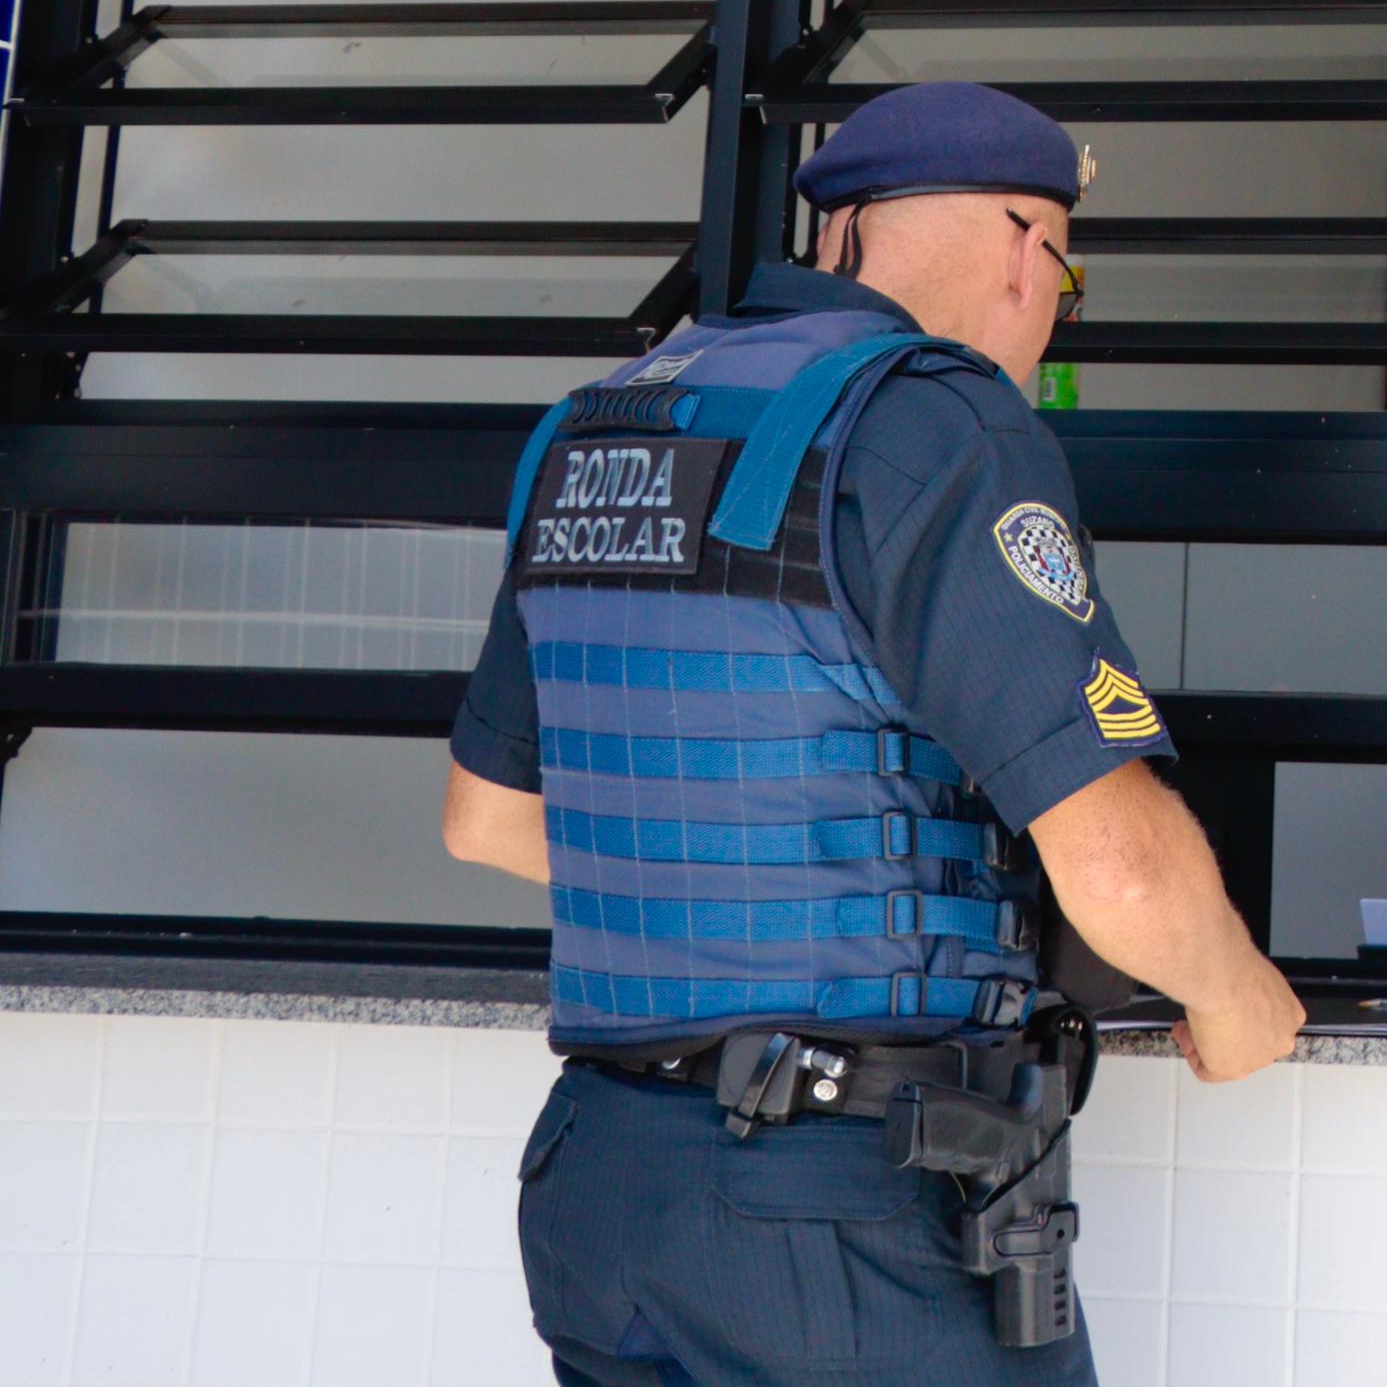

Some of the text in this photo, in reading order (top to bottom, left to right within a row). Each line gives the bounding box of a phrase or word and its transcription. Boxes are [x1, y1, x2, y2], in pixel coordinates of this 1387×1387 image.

[556, 447, 675, 509] RONDA
[532, 516, 687, 562] ESCOLAR
[1020, 515, 1055, 529] SUZANO
[1008, 545, 1064, 604] POLICIAMENTO
